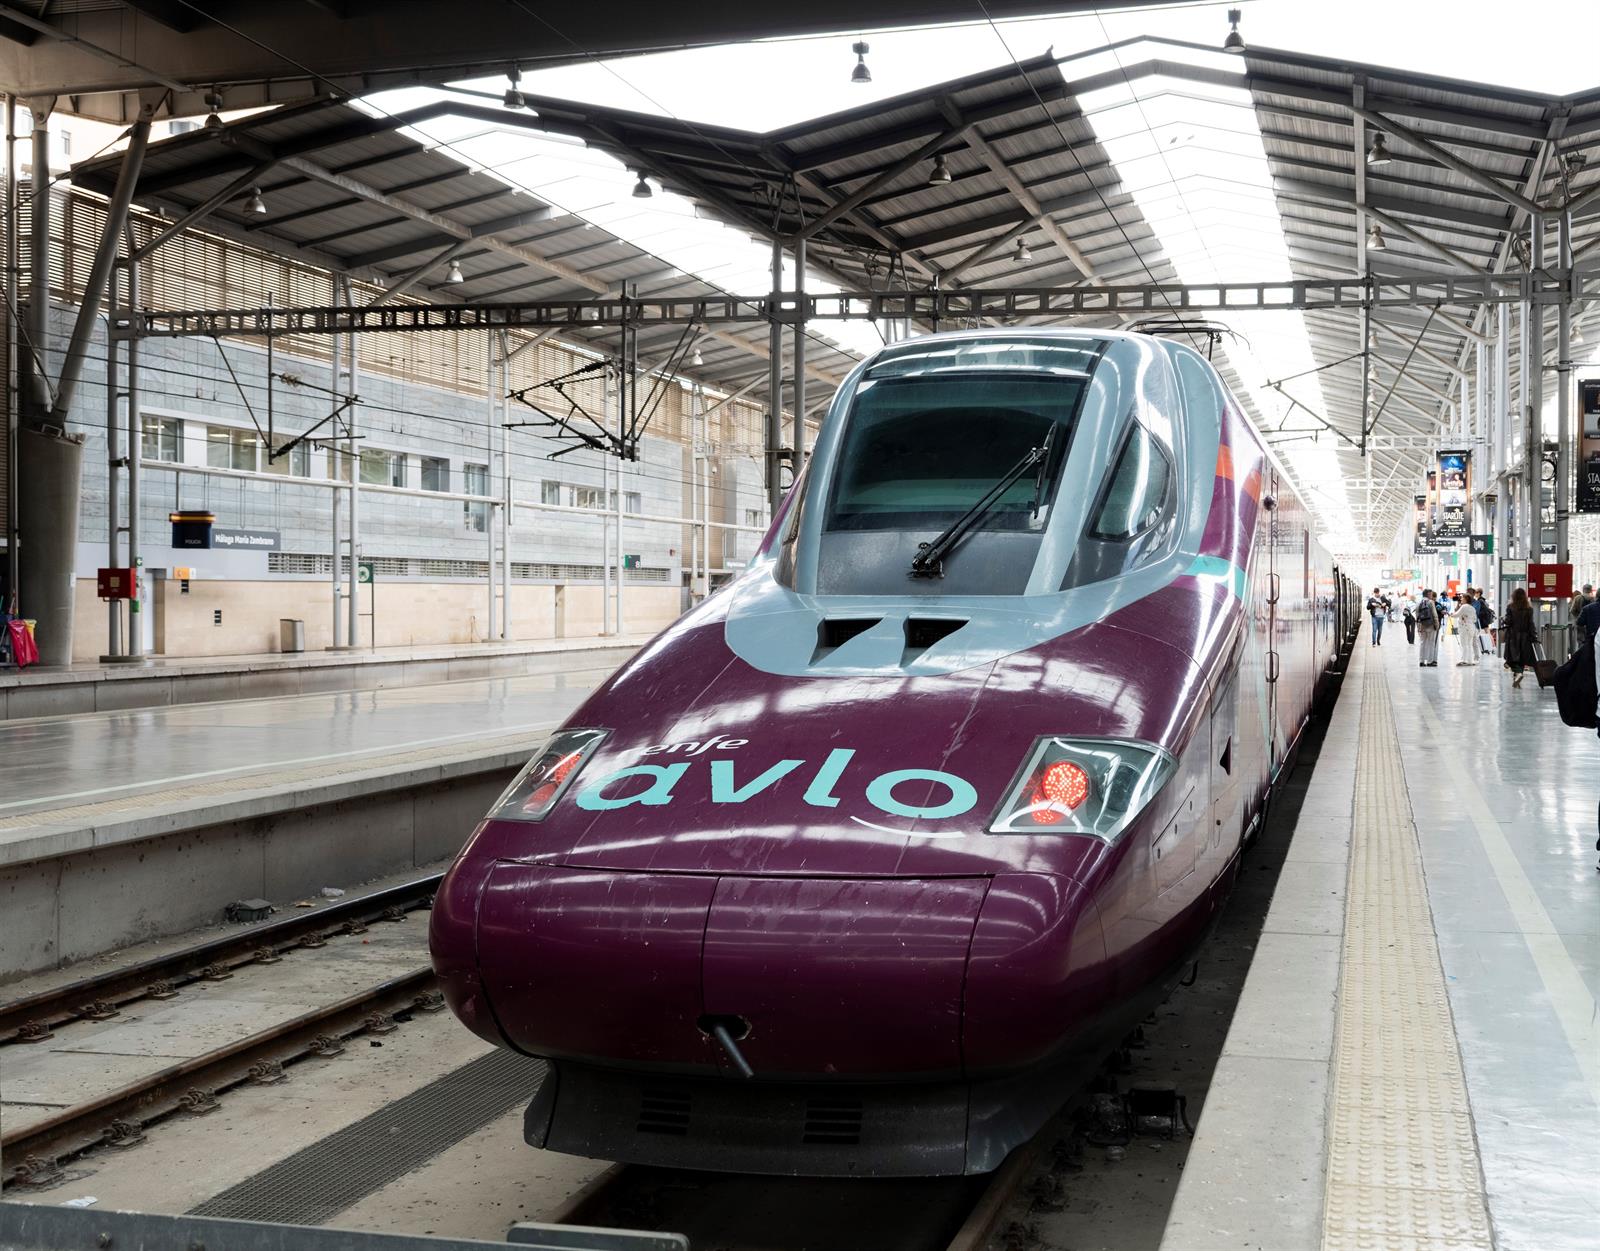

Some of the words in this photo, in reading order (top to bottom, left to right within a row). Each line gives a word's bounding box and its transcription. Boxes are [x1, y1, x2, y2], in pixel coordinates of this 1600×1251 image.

[215, 534, 234, 545] Málaga
[235, 535, 249, 544] María
[250, 536, 274, 545] Zambrano
[634, 734, 749, 757] enfe
[576, 748, 978, 819] avlo
